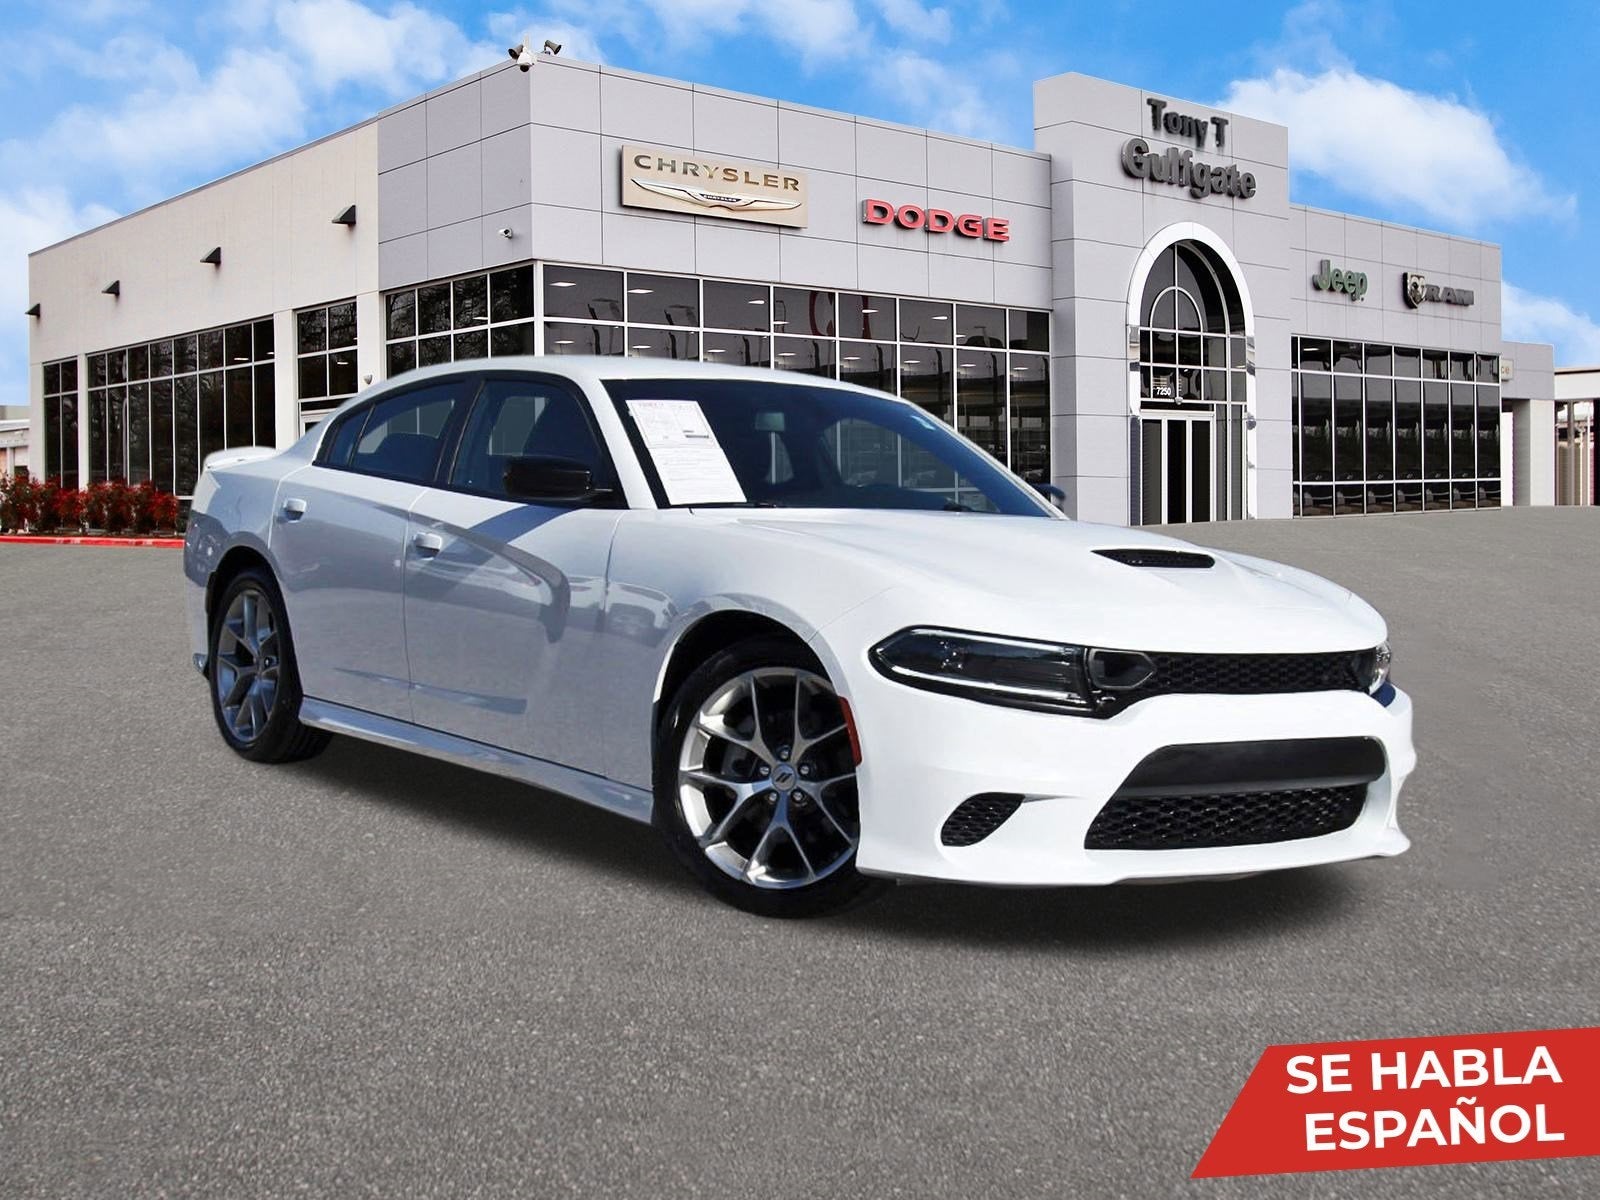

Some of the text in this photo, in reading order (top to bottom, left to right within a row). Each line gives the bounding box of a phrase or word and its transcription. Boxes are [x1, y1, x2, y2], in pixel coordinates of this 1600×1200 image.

[1147, 98, 1229, 148] Tony T
[633, 154, 800, 192] CHRYSLER
[1121, 138, 1257, 199] Gulfgate
[863, 198, 1011, 242] DODGE
[1311, 259, 1368, 302] Jeep
[1425, 284, 1474, 307] RAM
[1156, 387, 1172, 396] 7250
